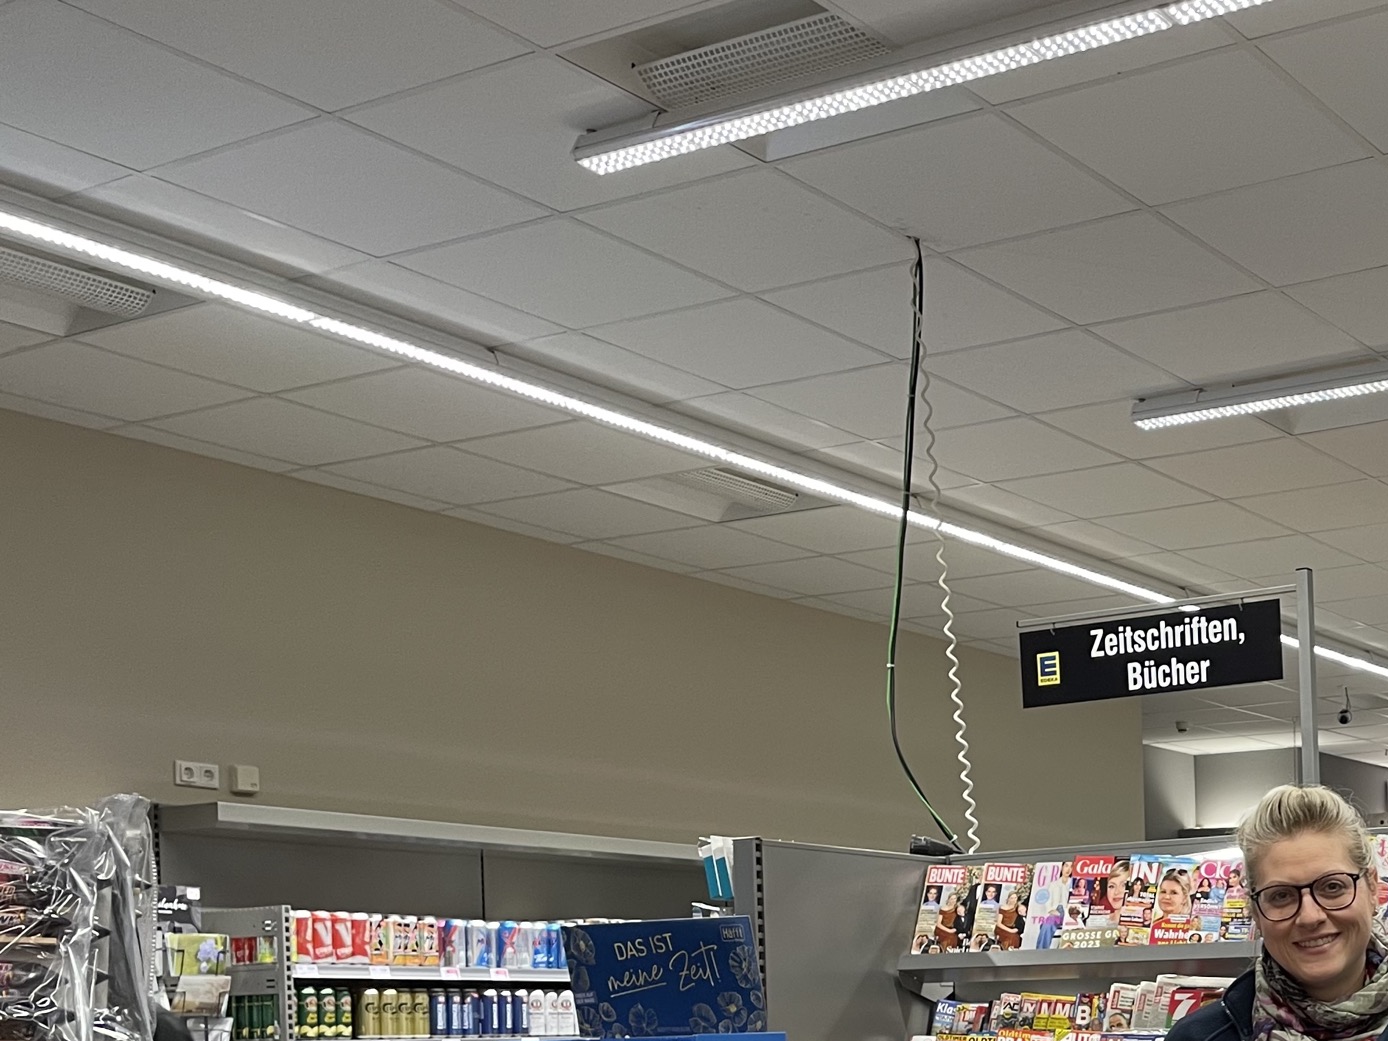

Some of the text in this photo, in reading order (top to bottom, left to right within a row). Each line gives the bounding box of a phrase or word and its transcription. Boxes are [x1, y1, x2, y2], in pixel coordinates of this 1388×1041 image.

[1090, 616, 1245, 658] Zeitschriften,
[1127, 657, 1210, 691] Bücher
[929, 868, 965, 883] BUNTE
[987, 867, 1025, 882] BUNTE
[1076, 859, 1111, 874] Gala
[614, 933, 673, 960] DAS IST
[607, 942, 722, 992] meine Zeit!
